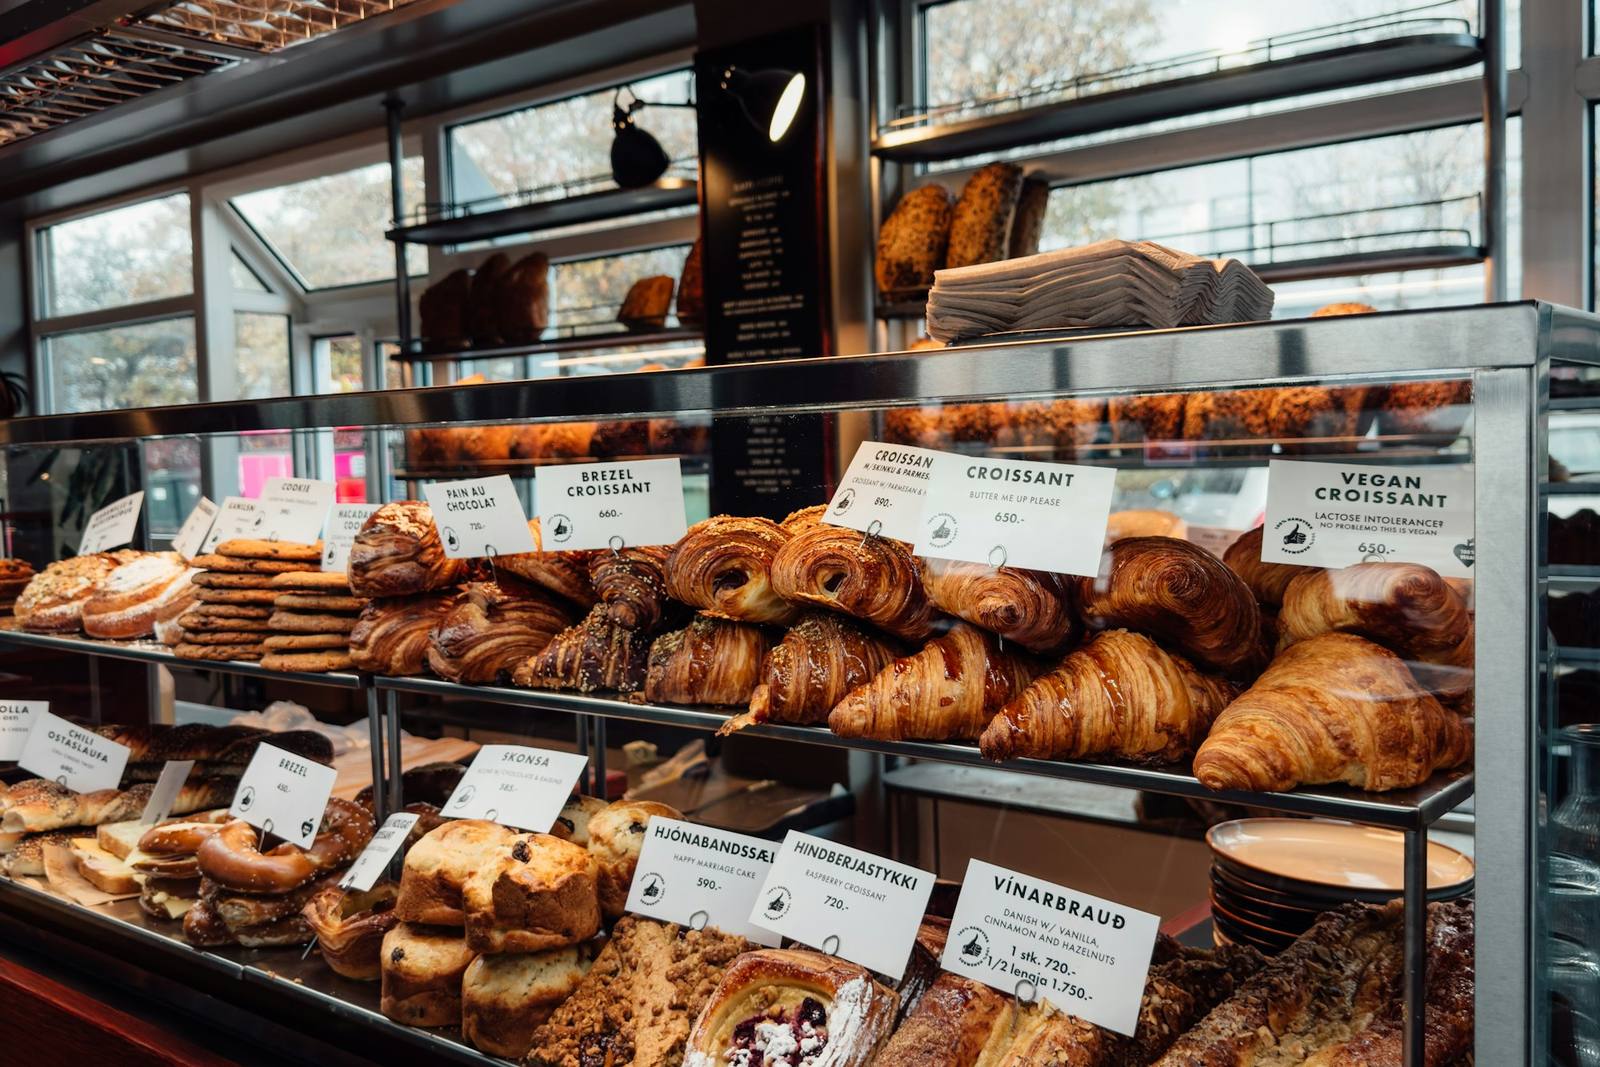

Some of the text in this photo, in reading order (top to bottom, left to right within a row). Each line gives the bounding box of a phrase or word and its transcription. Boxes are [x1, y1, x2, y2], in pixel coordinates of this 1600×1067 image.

[875, 450, 934, 469] CROISSAN
[581, 469, 634, 482] BREZEL
[966, 466, 1074, 487] CROISSANT
[1341, 472, 1421, 489] VEGAN
[282, 483, 311, 492] COOKIE
[446, 486, 486, 499] PAIN AU
[567, 482, 651, 497] CROISSANT
[447, 498, 496, 512] CHOCOLAT
[969, 490, 1061, 506] BUTTER ME UP PLEASE
[1314, 487, 1448, 508] CROISSANT
[338, 510, 375, 519] MACADA
[599, 509, 623, 518] 660.-
[994, 512, 1025, 524] 650.-
[1315, 512, 1444, 528] LACTOSE INTOLERANCE?
[344, 520, 363, 530] COO
[1335, 523, 1378, 532] PROBLEMO
[1399, 526, 1407, 534] IS
[1409, 528, 1438, 536] VEGAN
[1358, 542, 1396, 554] 650.-
[0, 705, 29, 714] OLLA
[68, 729, 95, 746] CHILI
[48, 731, 109, 763] OSTASLAUFA
[279, 758, 308, 777] BREZEL
[502, 752, 550, 767] SKONSA
[654, 826, 776, 864] HJÓNABANDSSÆL
[673, 854, 756, 880] HAPPY MARRIAGE CAKE
[794, 840, 918, 891] HINDBERJASTYKKI
[697, 877, 722, 891] 590.-
[805, 869, 887, 902] RASPBERRY CROISSANT
[823, 896, 849, 911] 720.-
[994, 875, 1126, 930] VÍNARBRAUÐ
[1003, 908, 1100, 949] DANISH W/ VANILLA,
[983, 914, 1116, 966] CINNAMON AND HAZELNUTS
[1011, 946, 1077, 976] 1 stk. 720.-
[986, 956, 1094, 1001] 1/2 lengja 1.750.-
